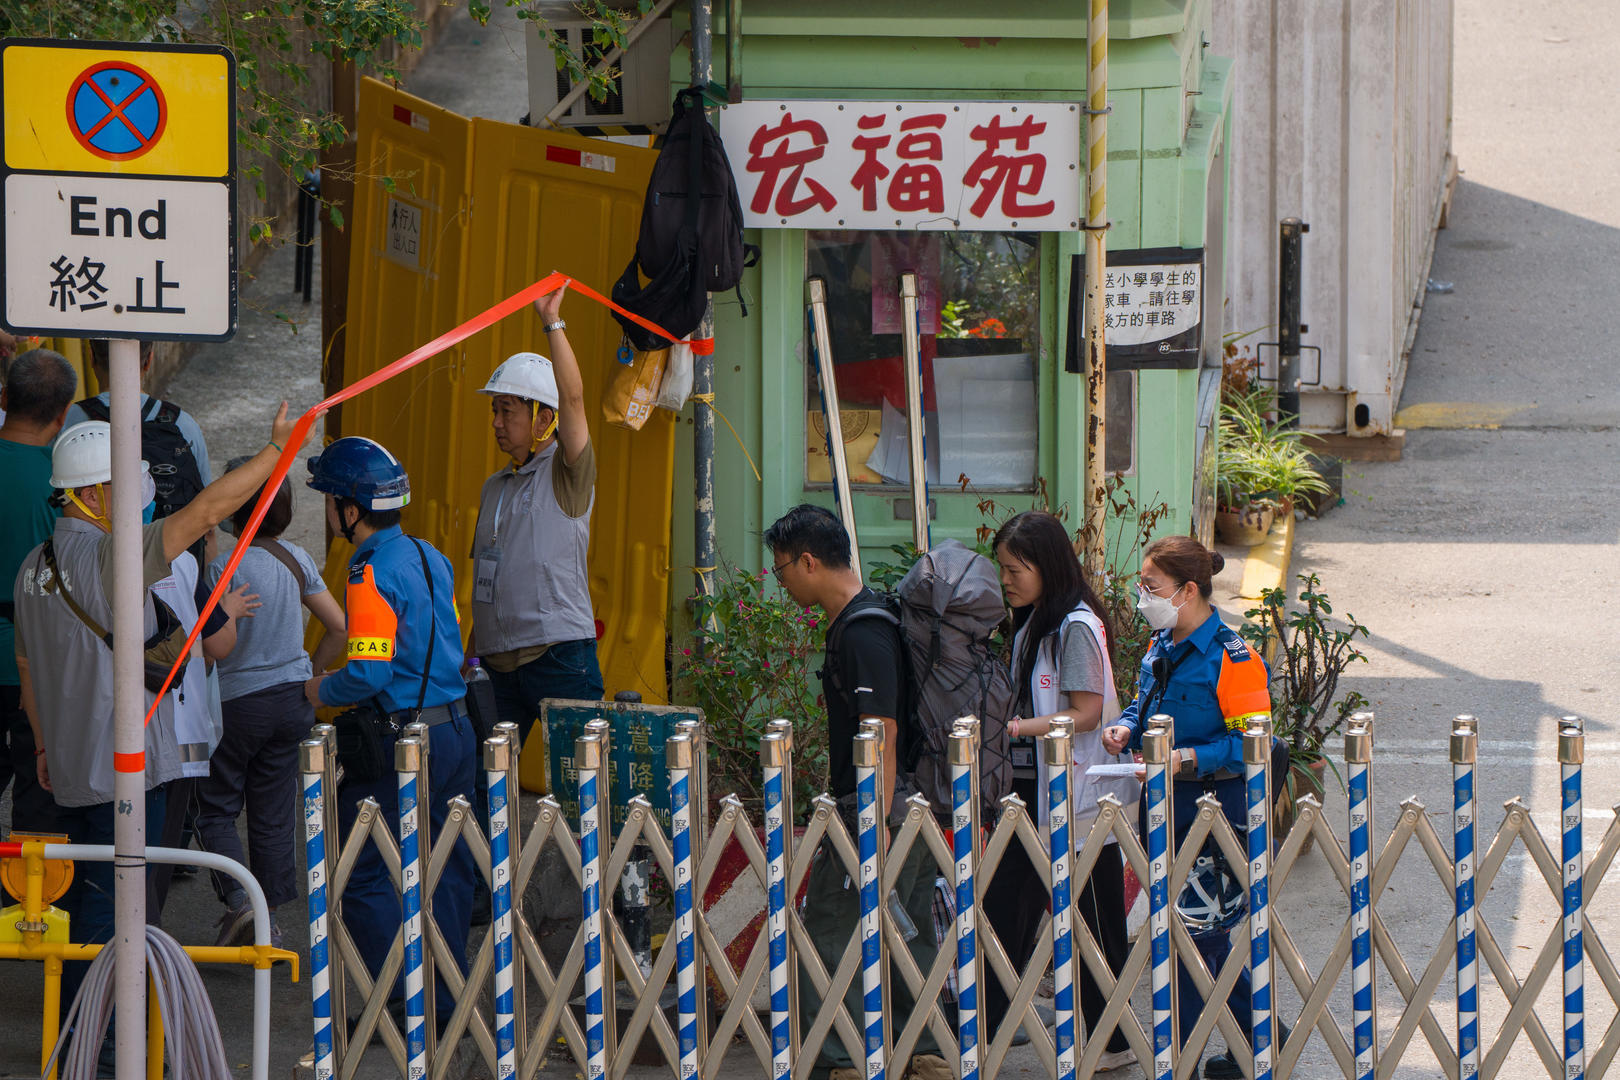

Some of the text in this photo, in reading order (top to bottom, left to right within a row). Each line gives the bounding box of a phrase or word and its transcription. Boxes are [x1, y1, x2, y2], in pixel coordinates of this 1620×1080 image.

[746, 111, 1054, 218] 宏福苑
[70, 195, 167, 240] End
[393, 232, 417, 255] 出入口
[399, 208, 417, 233] 行人
[49, 255, 186, 315] 終止
[356, 641, 388, 653] CAS
[311, 872, 323, 961] POLICE
[406, 871, 417, 960] POLICE
[496, 869, 508, 959] POLICE
[678, 868, 689, 957] POLICE
[770, 866, 782, 956] POLICE
[864, 866, 875, 956] POLICE
[959, 864, 970, 954] POLICE
[1253, 864, 1265, 954] POLICE
